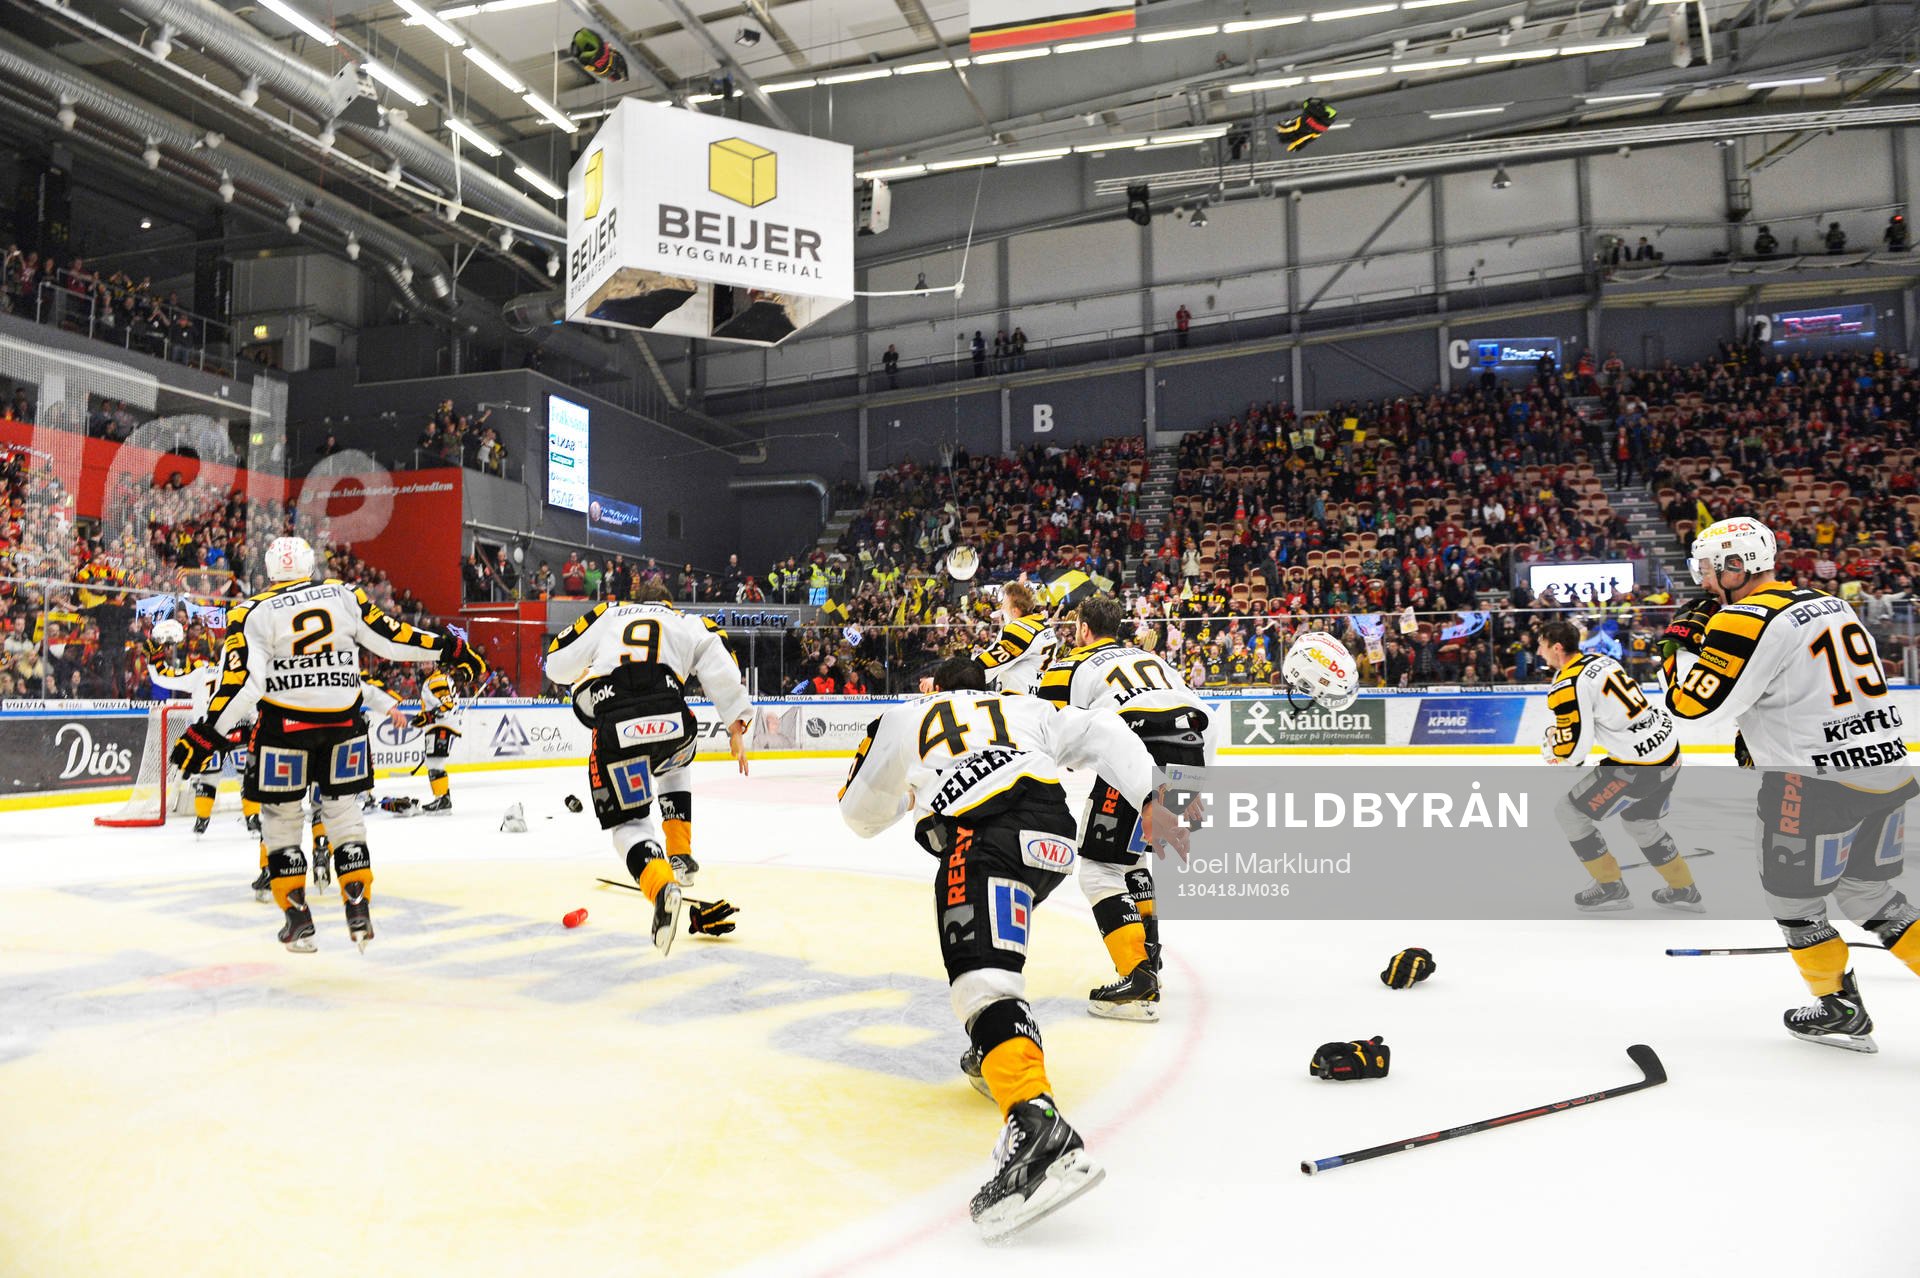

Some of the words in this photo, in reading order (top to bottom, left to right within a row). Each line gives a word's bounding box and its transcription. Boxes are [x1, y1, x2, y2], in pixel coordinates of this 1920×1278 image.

[571, 207, 617, 282] BEIJER
[658, 203, 822, 262] BEIJER
[658, 242, 823, 279] BYGGMATERIAL
[1449, 339, 1470, 369] C
[1033, 404, 1054, 432] B
[1744, 551, 1756, 561] 19
[272, 586, 341, 609] BOLIDEN
[292, 607, 334, 655] 2
[730, 610, 788, 628] hockey
[619, 619, 662, 664] 9
[228, 649, 243, 671] 2
[991, 645, 1011, 664] 70
[1307, 647, 1345, 679] skebo
[1700, 651, 1729, 668] Reebok
[1809, 622, 1888, 708] 19
[1683, 669, 1721, 699] 19
[93, 701, 128, 709] VOLVIA
[530, 726, 562, 742] SCA
[634, 718, 669, 738] NKL
[829, 721, 867, 732] handic
[919, 698, 1019, 761] 41
[1427, 716, 1468, 727] KPMG
[1280, 732, 1307, 741] Bygger
[1309, 732, 1320, 741] på
[55, 722, 132, 779] Diös
[1779, 772, 1803, 834] REPA
[1037, 841, 1068, 864] NKL
